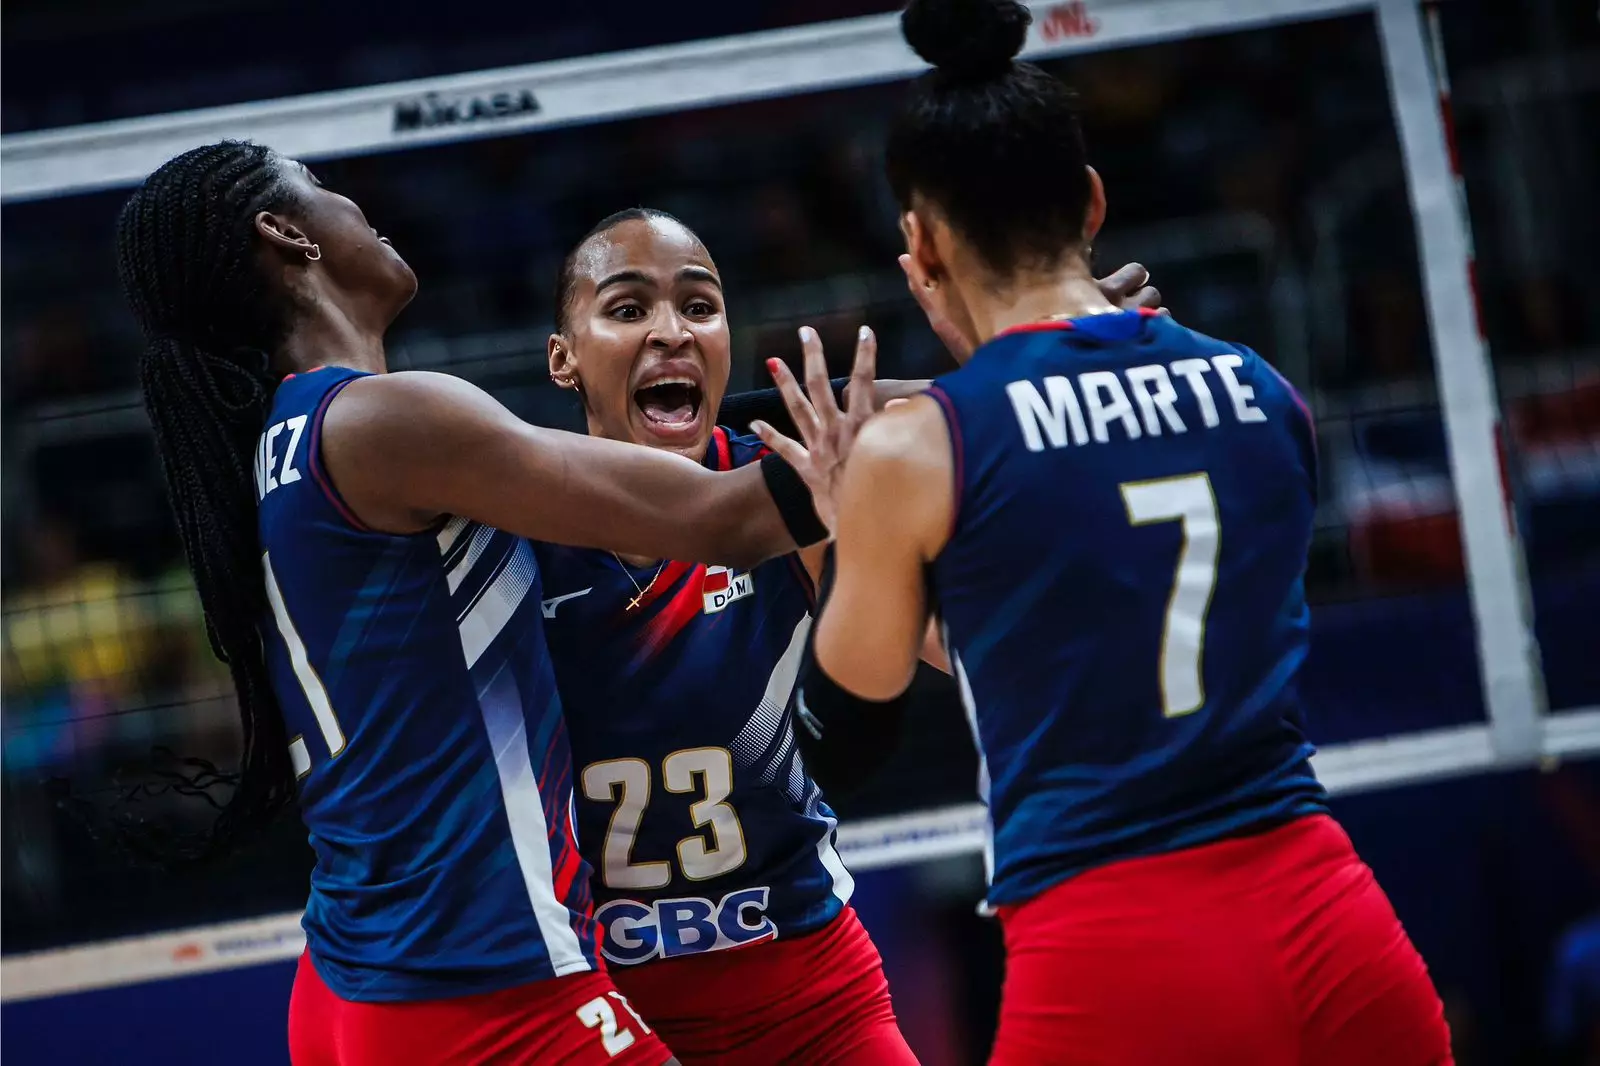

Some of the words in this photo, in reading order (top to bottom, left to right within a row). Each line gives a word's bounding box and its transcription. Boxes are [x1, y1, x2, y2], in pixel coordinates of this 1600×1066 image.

[1004, 353, 1268, 452] MARTE
[713, 579, 747, 608] DOM
[1118, 470, 1222, 719] 7
[581, 746, 748, 890] 23
[593, 886, 778, 965] GBC
